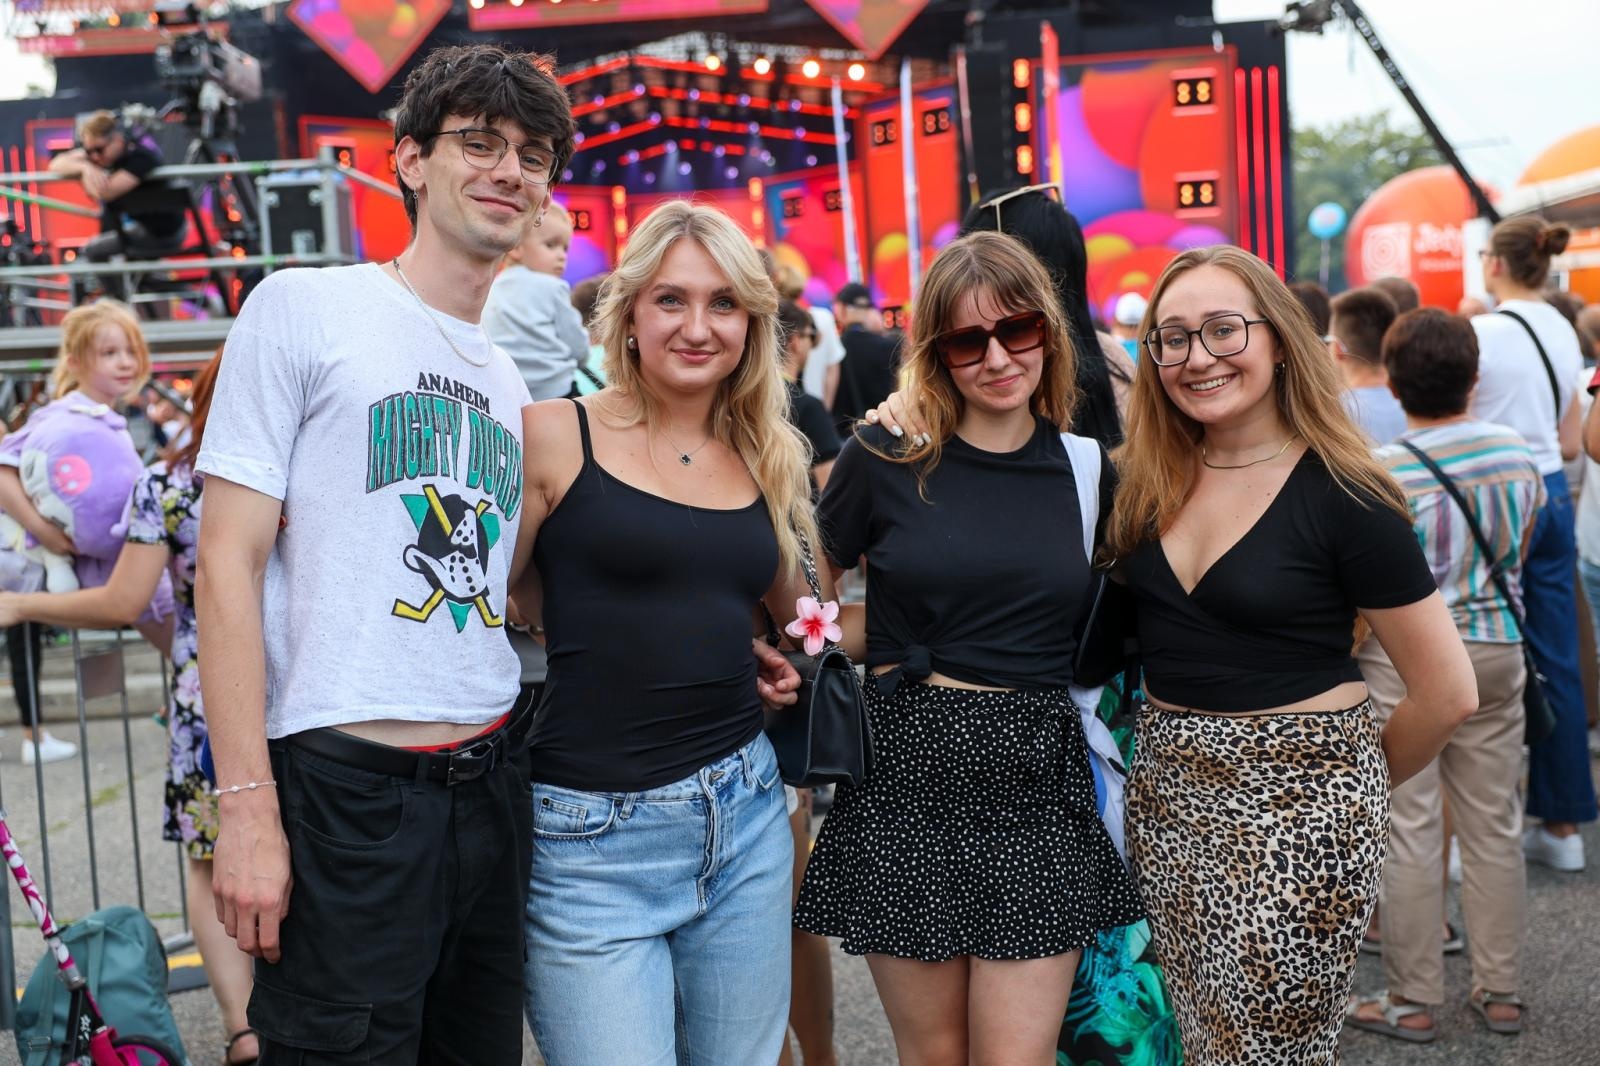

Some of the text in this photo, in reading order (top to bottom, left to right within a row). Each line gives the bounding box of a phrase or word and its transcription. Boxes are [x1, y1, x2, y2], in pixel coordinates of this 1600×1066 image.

[417, 372, 490, 414] ANAHEIM
[366, 390, 523, 521] MIGHTY DUCKS
